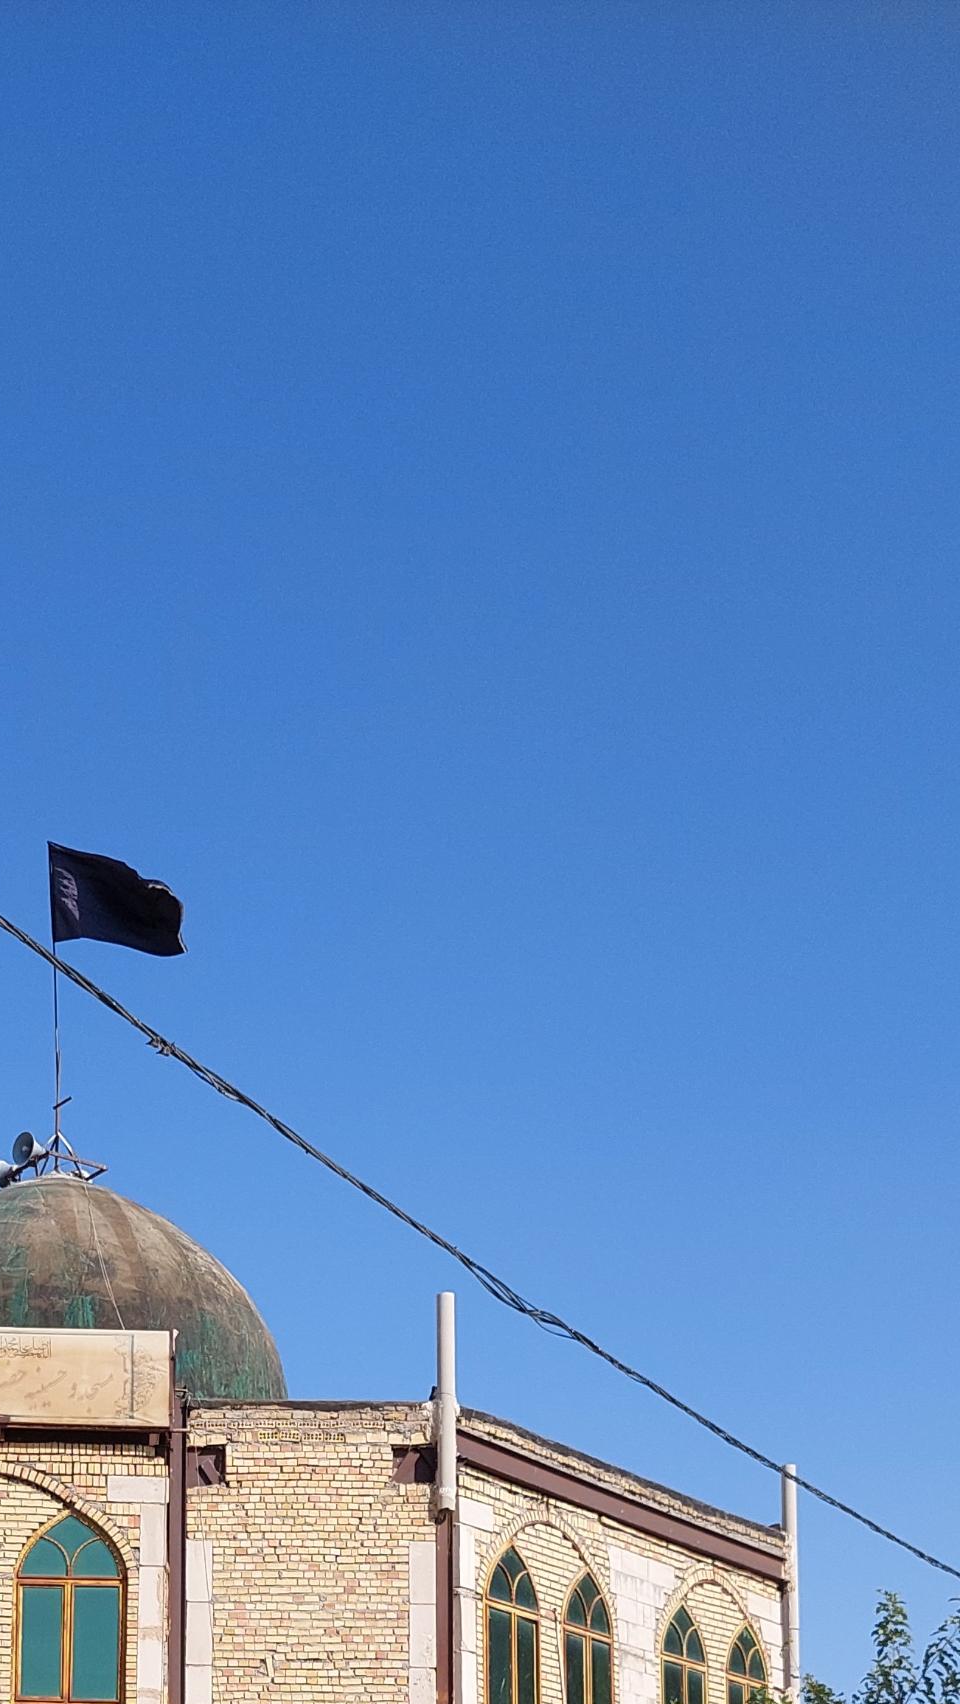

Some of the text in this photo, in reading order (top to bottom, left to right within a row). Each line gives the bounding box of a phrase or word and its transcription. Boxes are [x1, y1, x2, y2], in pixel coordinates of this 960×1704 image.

[24, 1366, 67, 1411] حسینیه
[68, 1381, 78, 1399] و
[77, 1373, 113, 1413] مسجد
